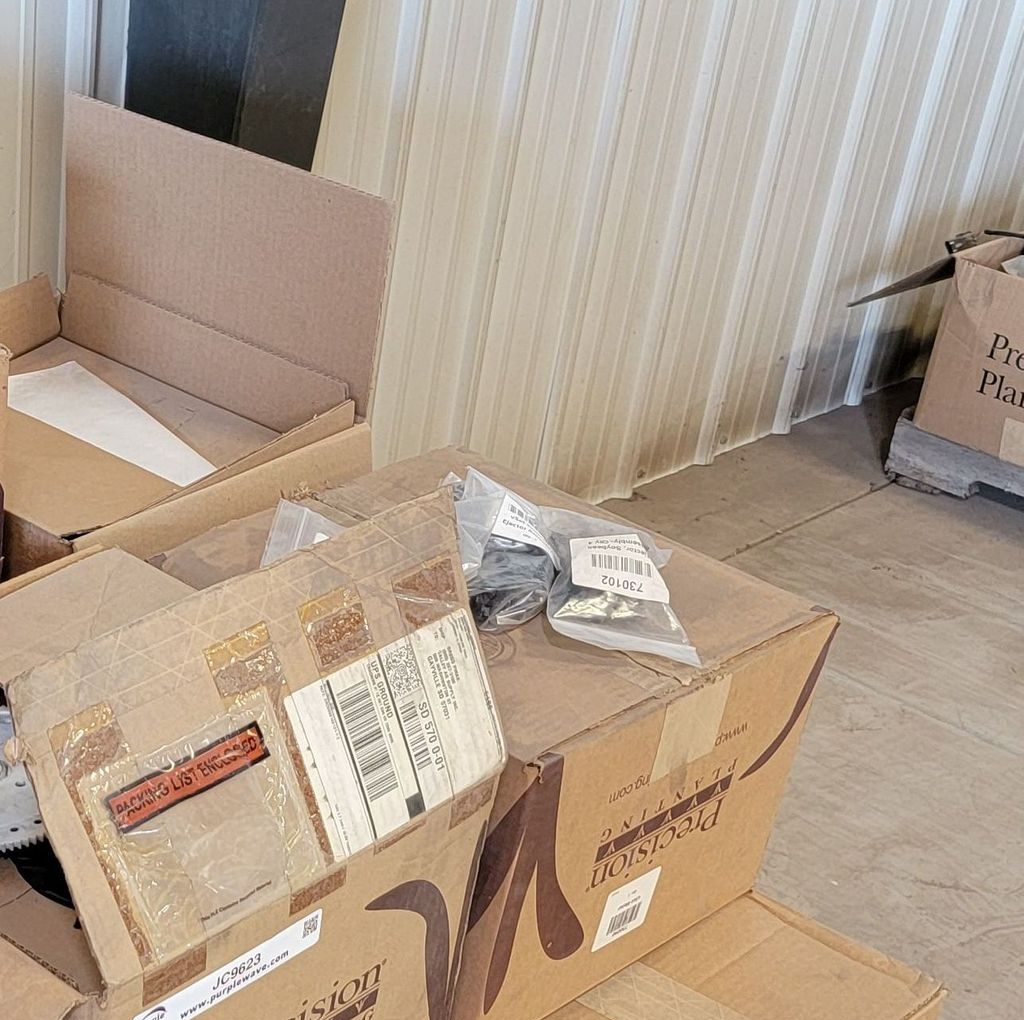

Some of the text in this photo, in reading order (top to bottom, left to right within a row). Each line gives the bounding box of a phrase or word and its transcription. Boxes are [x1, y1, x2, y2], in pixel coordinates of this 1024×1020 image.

[601, 575, 644, 593] 730102
[371, 660, 379, 683] UPS
[377, 681, 394, 719] GROUND
[418, 701, 430, 719] SD
[425, 722, 438, 744] 570
[600, 757, 739, 843] PLANTING
[179, 950, 289, 1020] www.purplewave.com
[212, 953, 262, 991] JC9623
